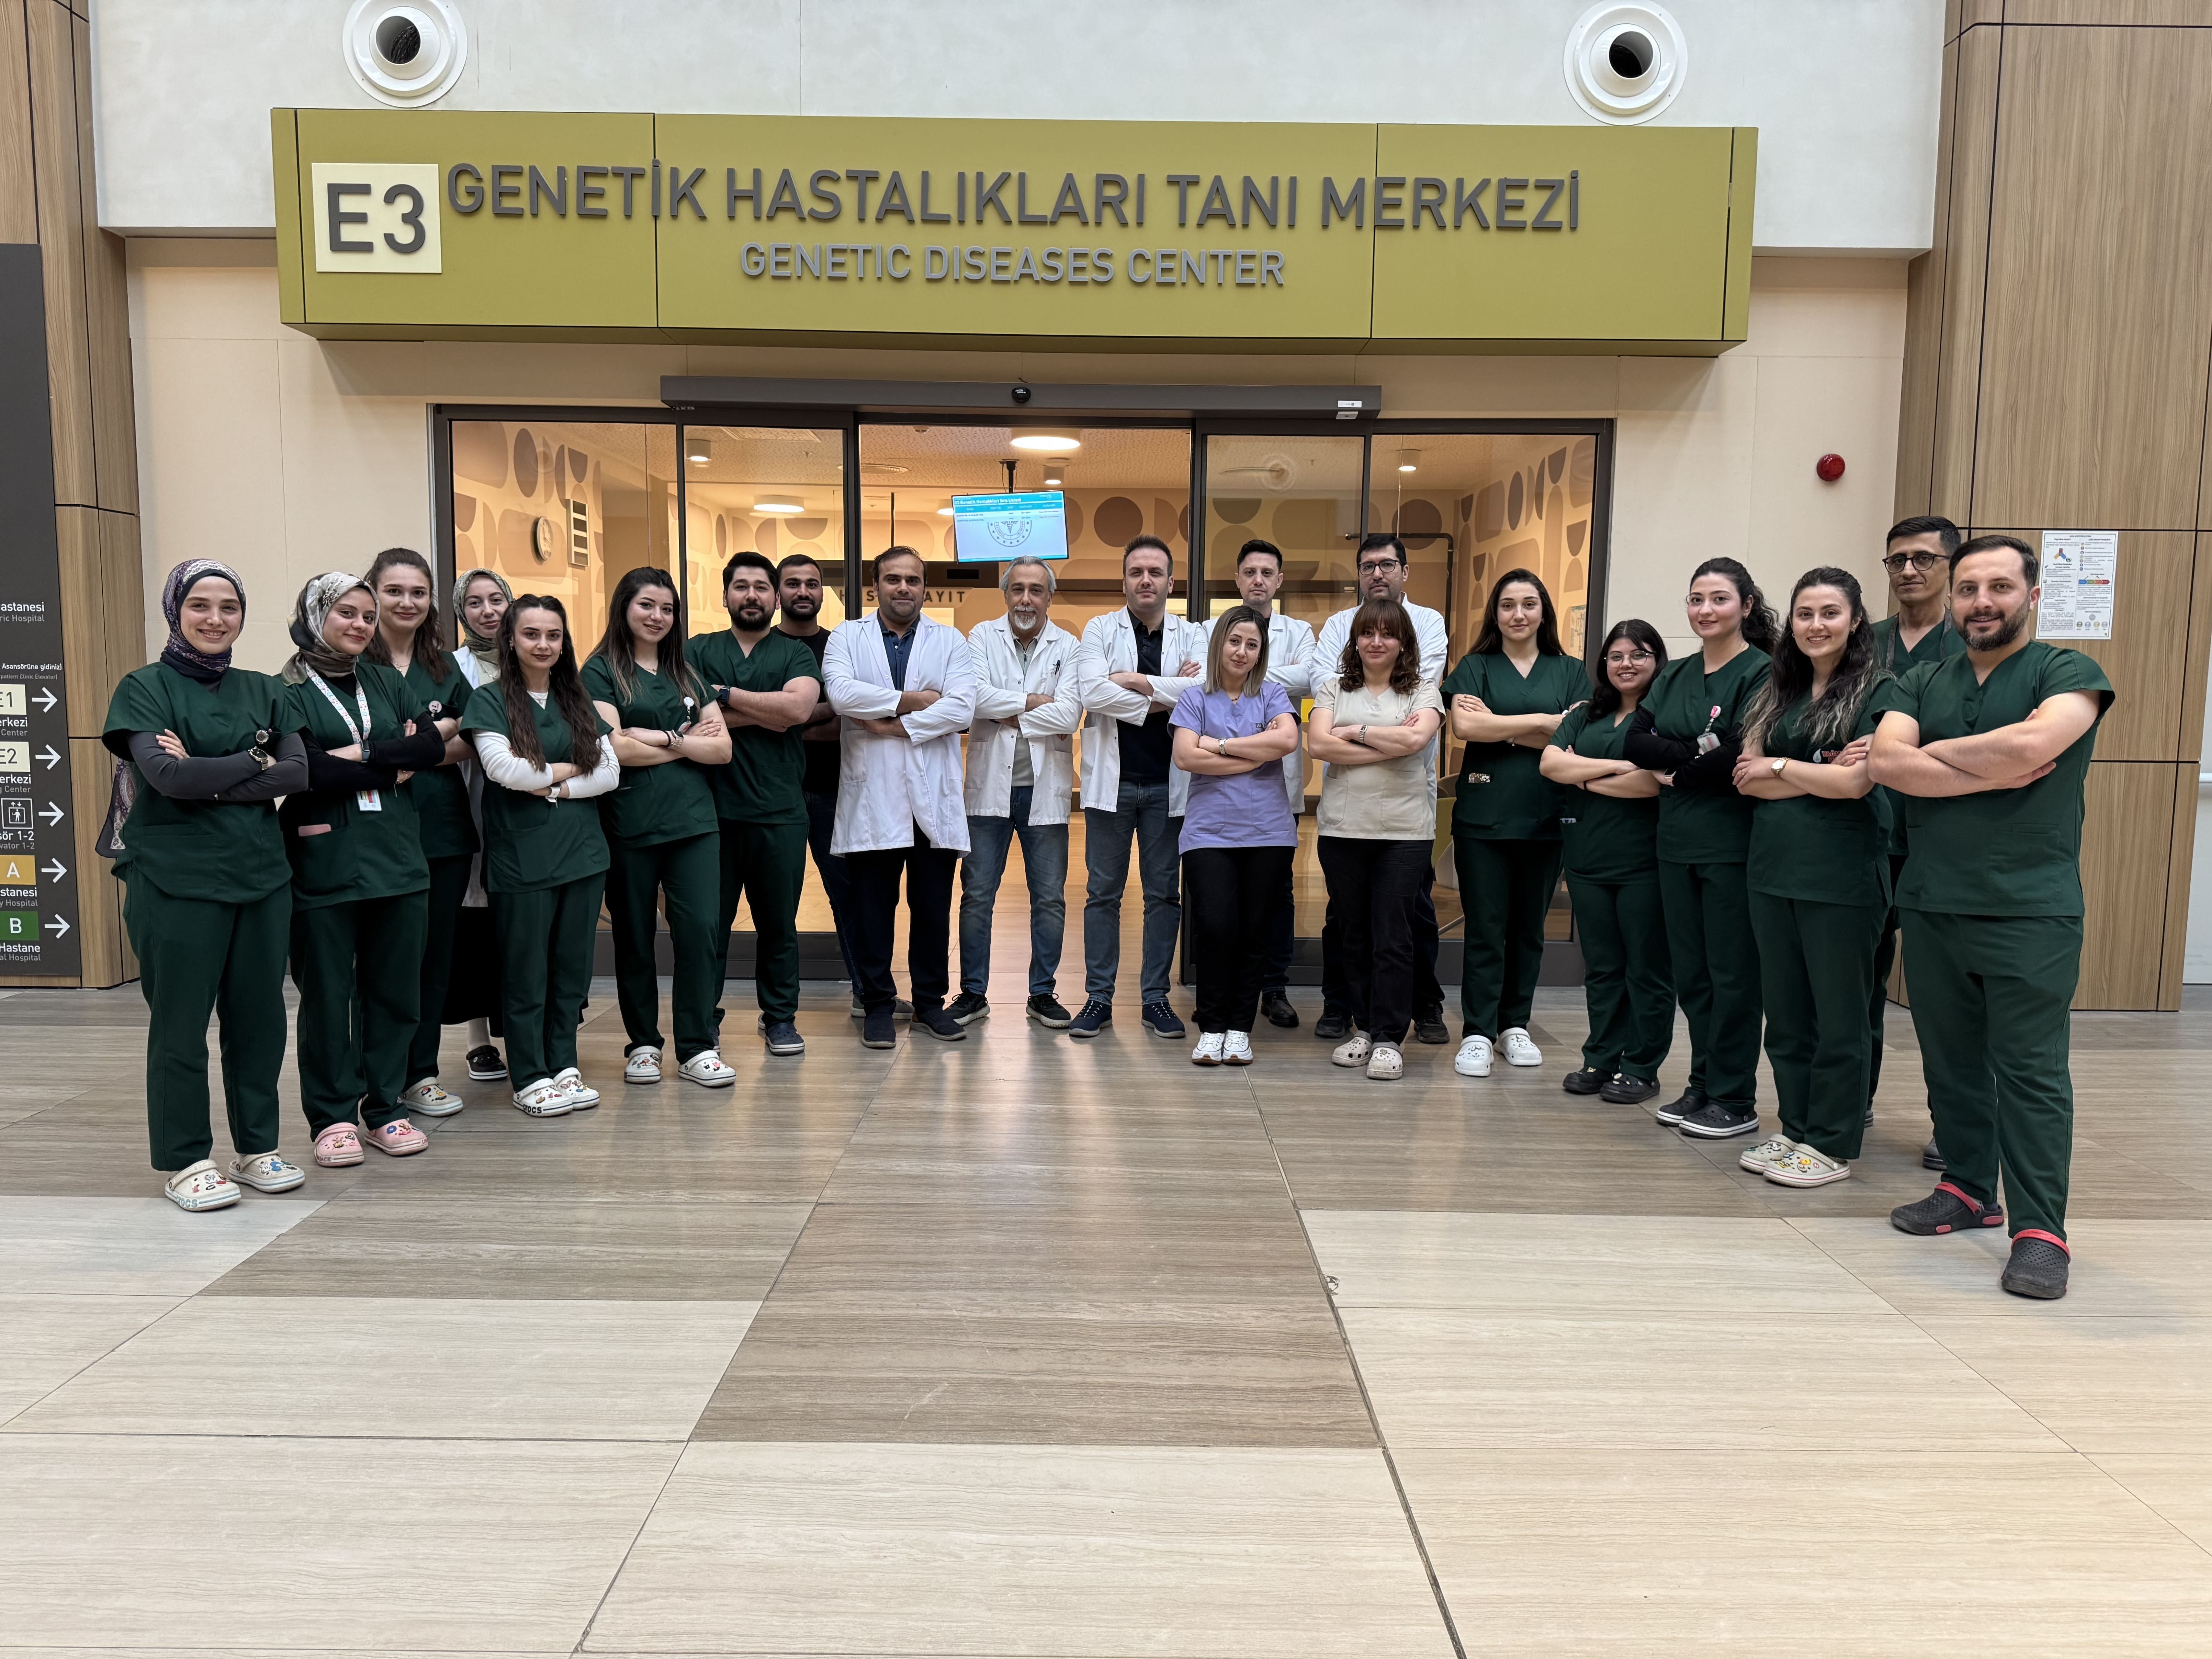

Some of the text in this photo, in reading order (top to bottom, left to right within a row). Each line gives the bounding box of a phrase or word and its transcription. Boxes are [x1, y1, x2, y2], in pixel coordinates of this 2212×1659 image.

[448, 158, 1580, 228] GENETİK HASTALIKLARI TANI MERKEZİ
[326, 183, 427, 254] E3
[740, 242, 1285, 285] GENETIC DISEASES CENTER
[924, 591, 965, 603] AYIT
[12, 614, 45, 623] Hospital
[4, 785, 31, 793] Center
[17, 831, 34, 841] 1-2
[7, 862, 21, 878] A
[6, 899, 38, 908] Hospital
[10, 918, 22, 934] B
[0, 942, 41, 953] Hastane
[9, 954, 41, 963] Hospital
